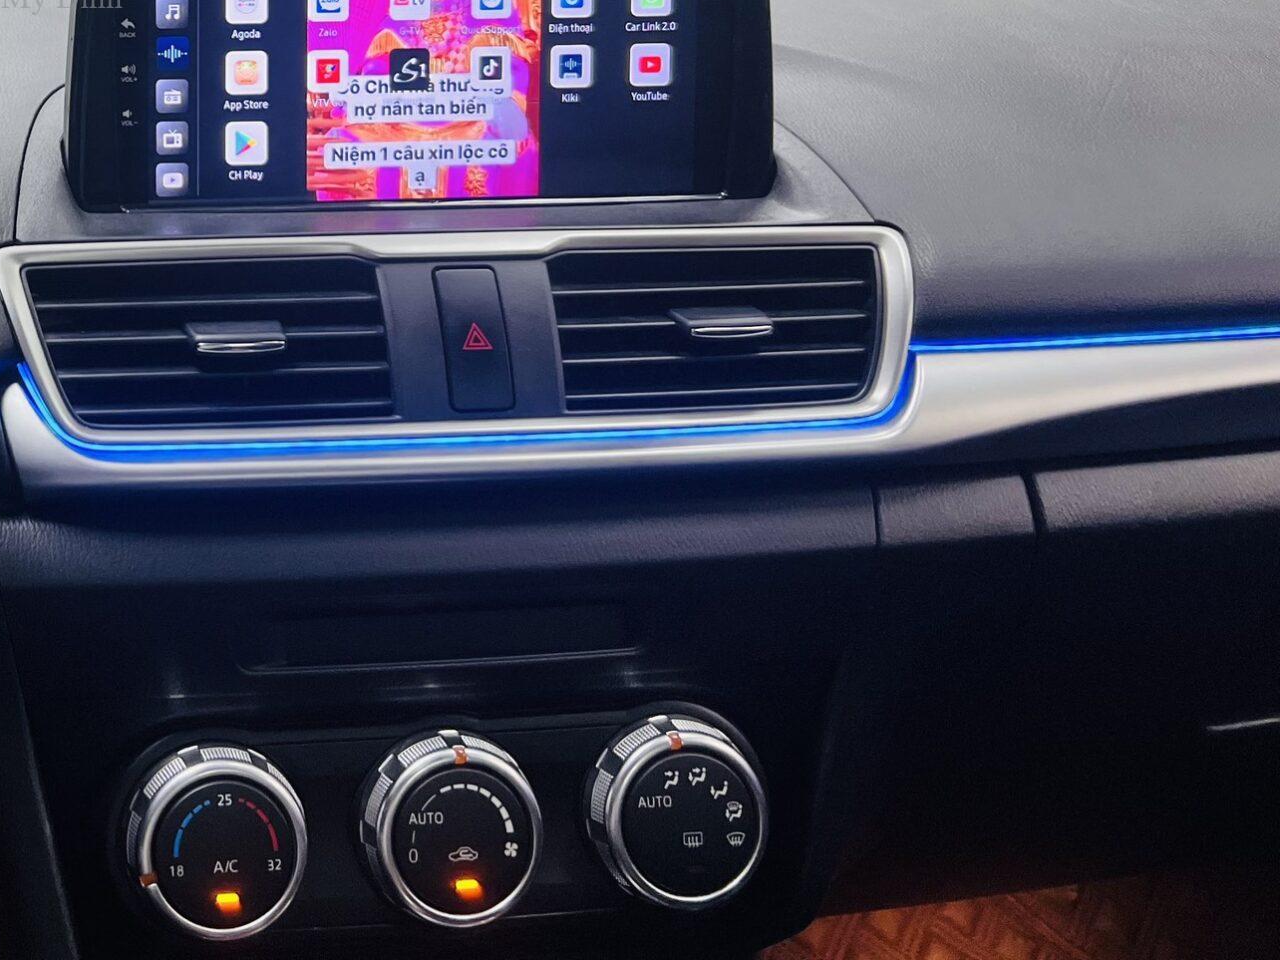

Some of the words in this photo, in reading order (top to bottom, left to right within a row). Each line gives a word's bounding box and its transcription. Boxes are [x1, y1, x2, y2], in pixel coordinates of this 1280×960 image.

[318, 28, 338, 37] Zalo
[548, 23, 569, 34] Điện
[570, 23, 593, 34] thoại
[625, 23, 640, 32] Car
[642, 22, 661, 31] Link
[661, 22, 676, 31] 2.0
[231, 29, 262, 40] Agoda
[561, 94, 579, 103] Kiki
[631, 92, 669, 101] YouTube
[223, 101, 241, 112] App
[243, 100, 269, 110] Store
[354, 104, 376, 121] nợ
[419, 102, 445, 116] tan
[450, 96, 487, 115] biến
[331, 146, 376, 166] Niệm
[379, 147, 388, 161] 1
[393, 145, 424, 161] câu
[428, 145, 454, 160] xin
[458, 144, 484, 164] lộc
[488, 144, 508, 159] cô
[228, 170, 241, 180] CH
[243, 170, 264, 181] Play
[414, 171, 426, 186] ạ
[217, 794, 233, 807] 25
[638, 795, 673, 809] AUTO
[408, 811, 444, 825] AUTO
[408, 848, 419, 864] 0
[212, 859, 239, 874] A/C
[267, 858, 282, 871] 32
[170, 865, 185, 878] 18
